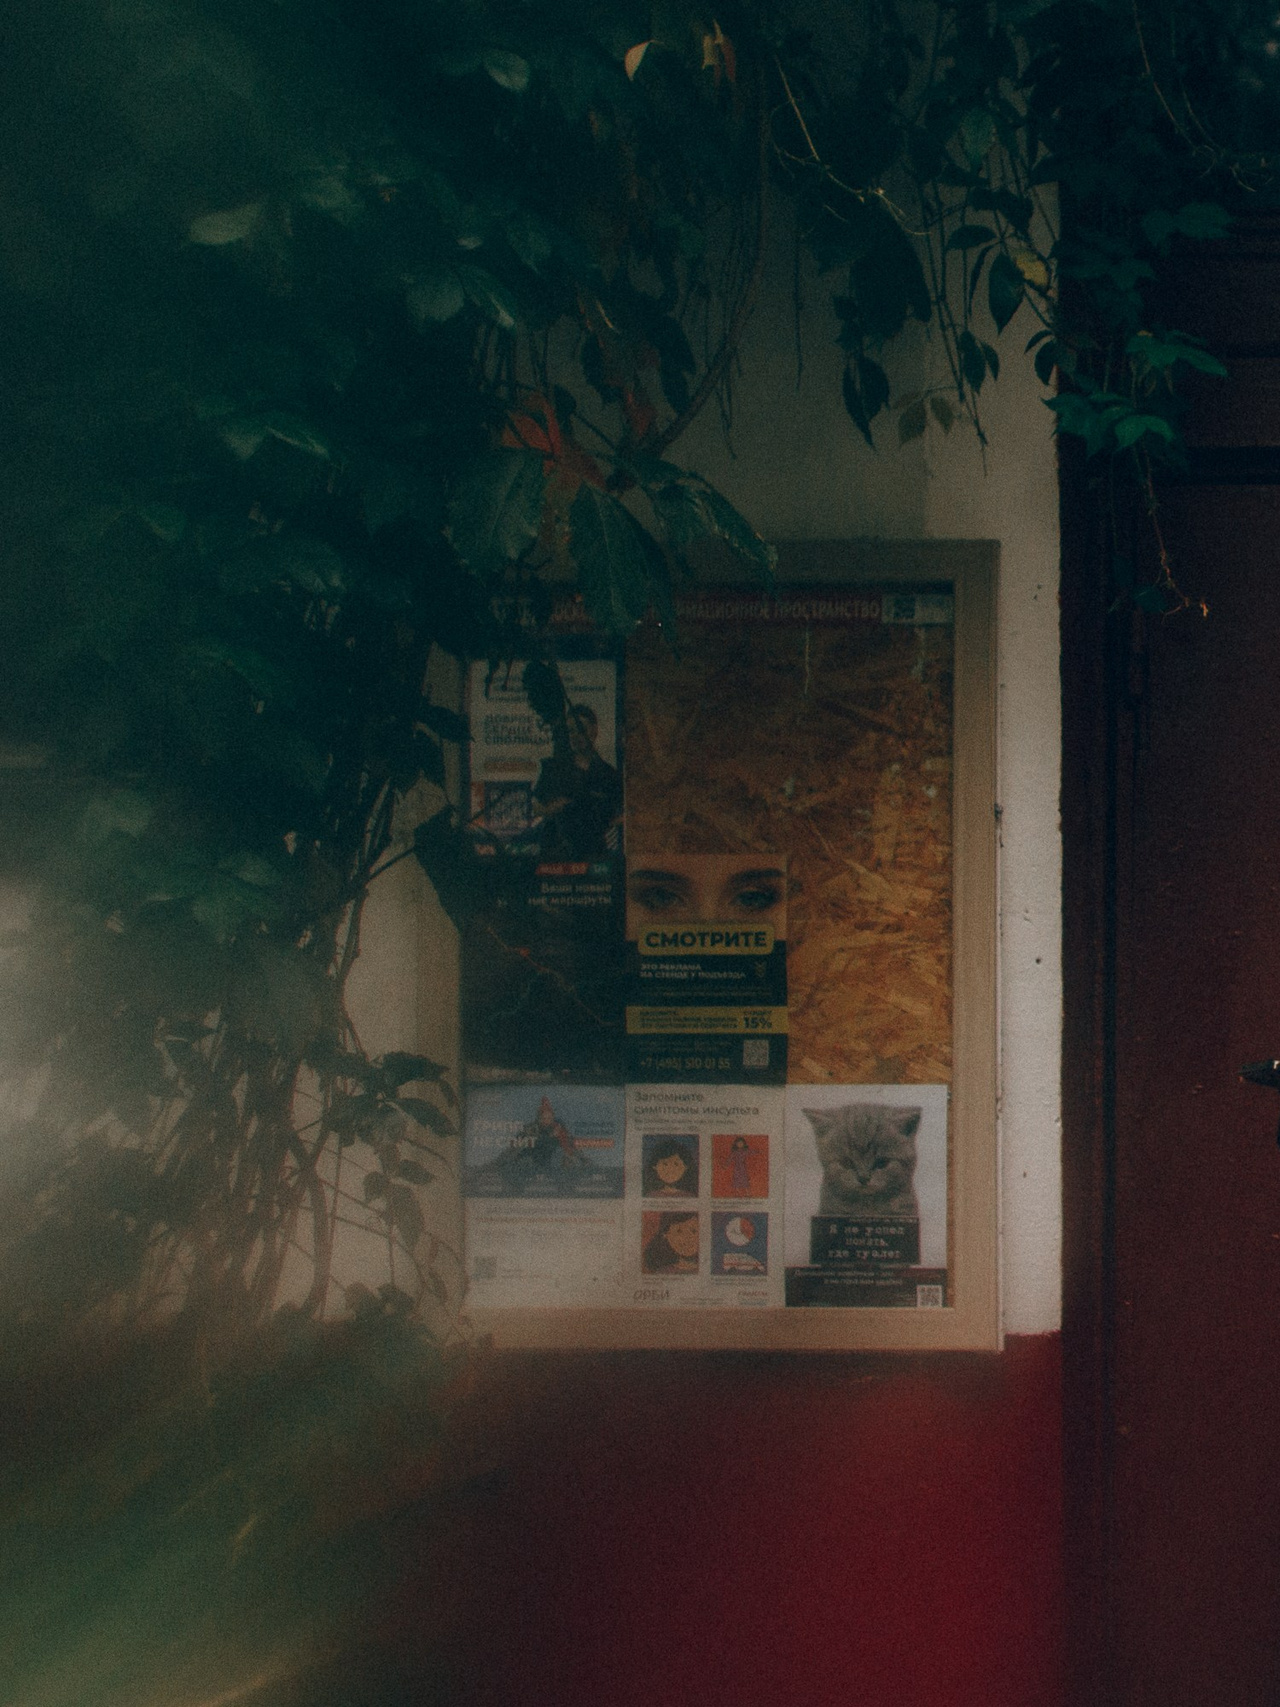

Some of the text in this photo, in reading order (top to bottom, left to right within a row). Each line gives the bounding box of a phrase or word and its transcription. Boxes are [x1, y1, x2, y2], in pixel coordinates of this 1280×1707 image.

[644, 931, 767, 948] СМОТРИТЕ
[744, 1017, 773, 1029] 15%
[634, 1091, 705, 1102] Запомните
[634, 1107, 760, 1118] симптомы инсульта
